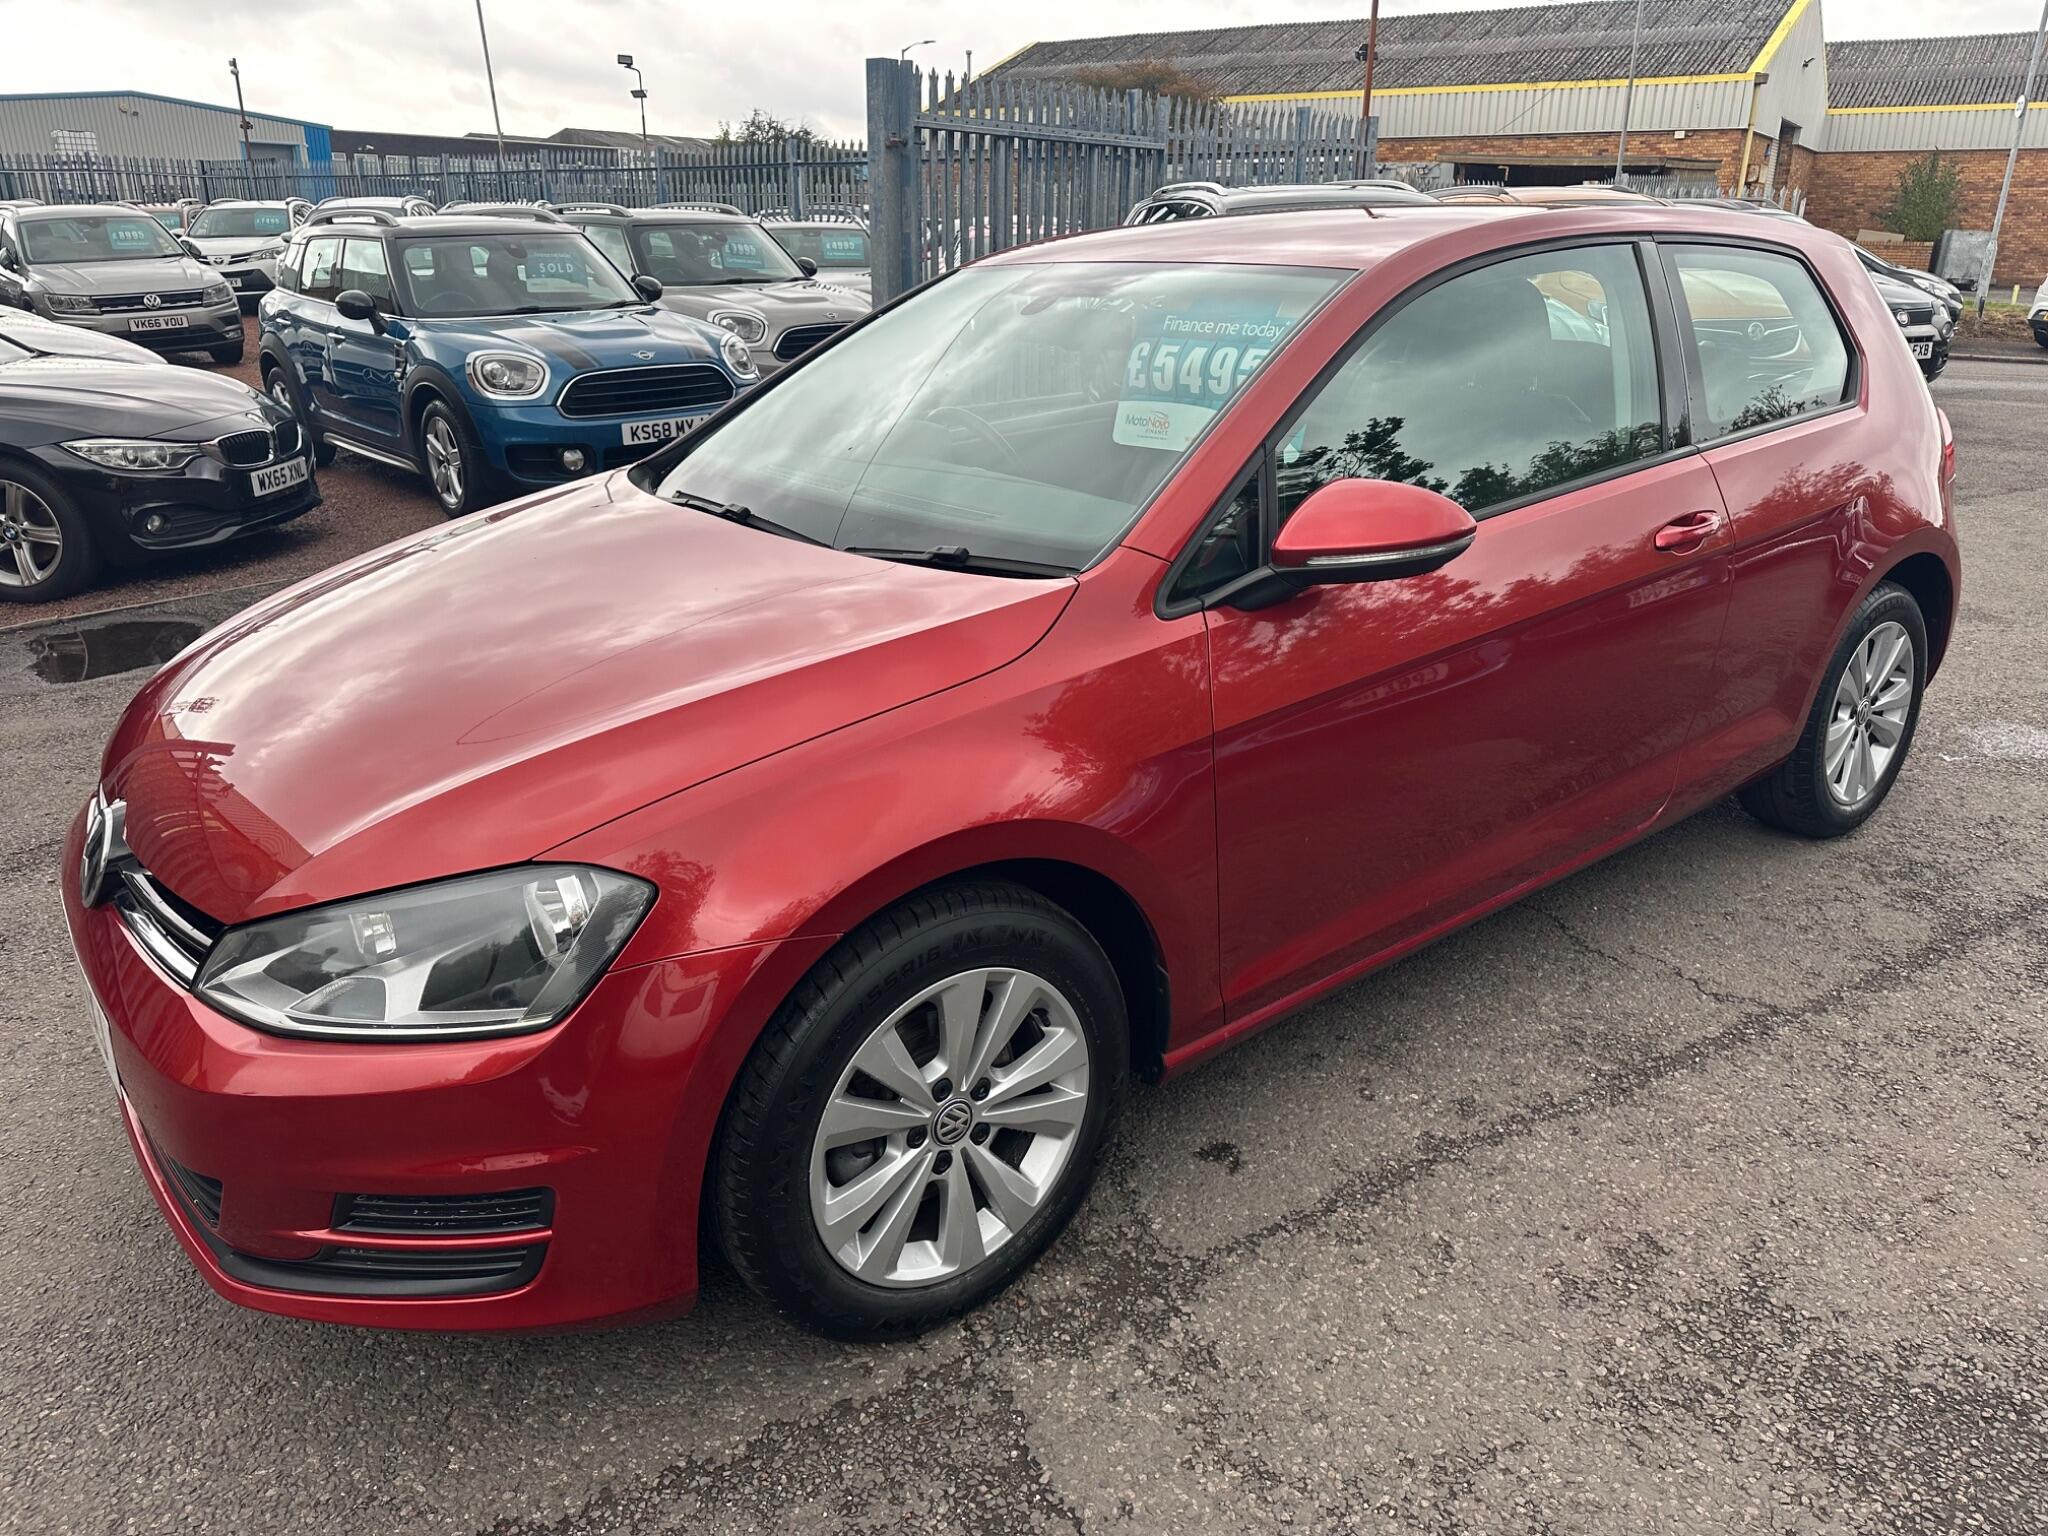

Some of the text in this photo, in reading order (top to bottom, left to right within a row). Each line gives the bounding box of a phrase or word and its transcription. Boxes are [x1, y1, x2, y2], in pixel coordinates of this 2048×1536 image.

[539, 262, 574, 273] SOLD
[133, 317, 184, 329] VK66 VOU
[1162, 314, 1214, 333] Finance
[1215, 321, 1239, 335] me
[1125, 413, 1170, 431] MotoNovo
[630, 421, 672, 442] KS68
[1145, 428, 1168, 436] FINANCE
[257, 461, 305, 492] WX65 XNL
